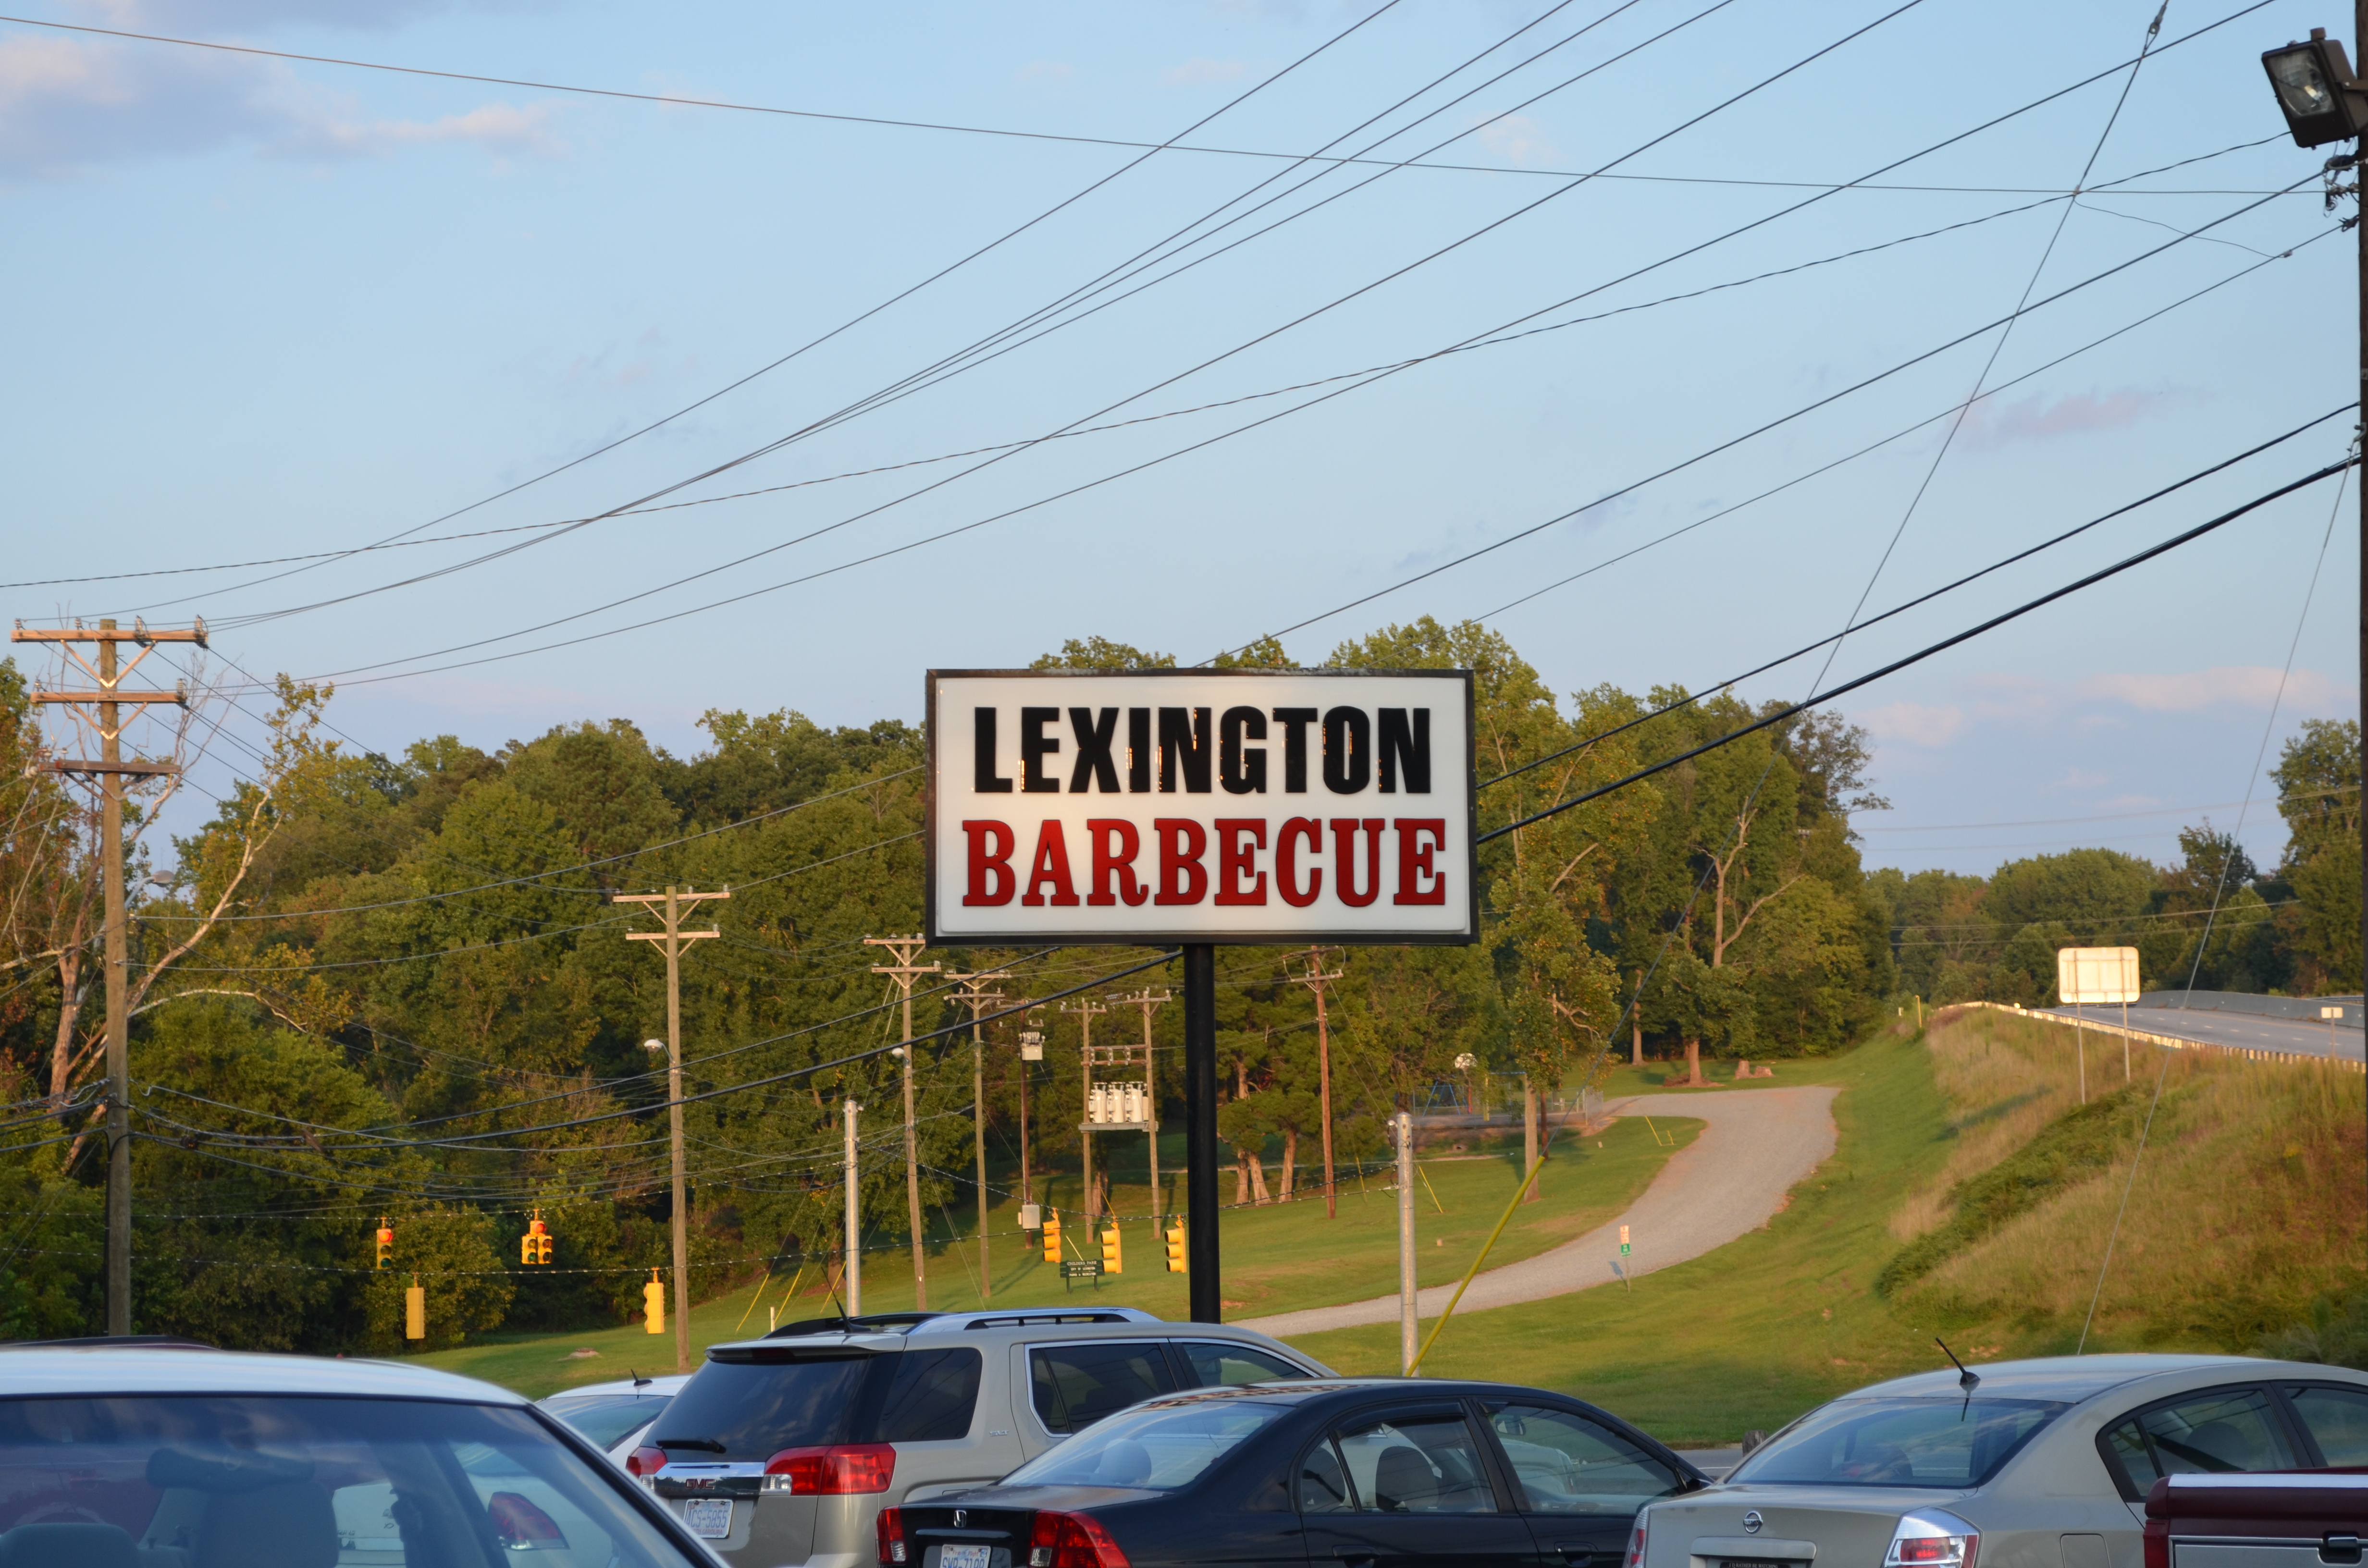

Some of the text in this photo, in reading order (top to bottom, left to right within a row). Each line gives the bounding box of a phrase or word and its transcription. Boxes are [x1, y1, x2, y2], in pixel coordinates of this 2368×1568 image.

[974, 705, 1431, 795] LEXINGTON
[962, 816, 1445, 907] BARBECUE
[685, 1479, 716, 1490] GMC
